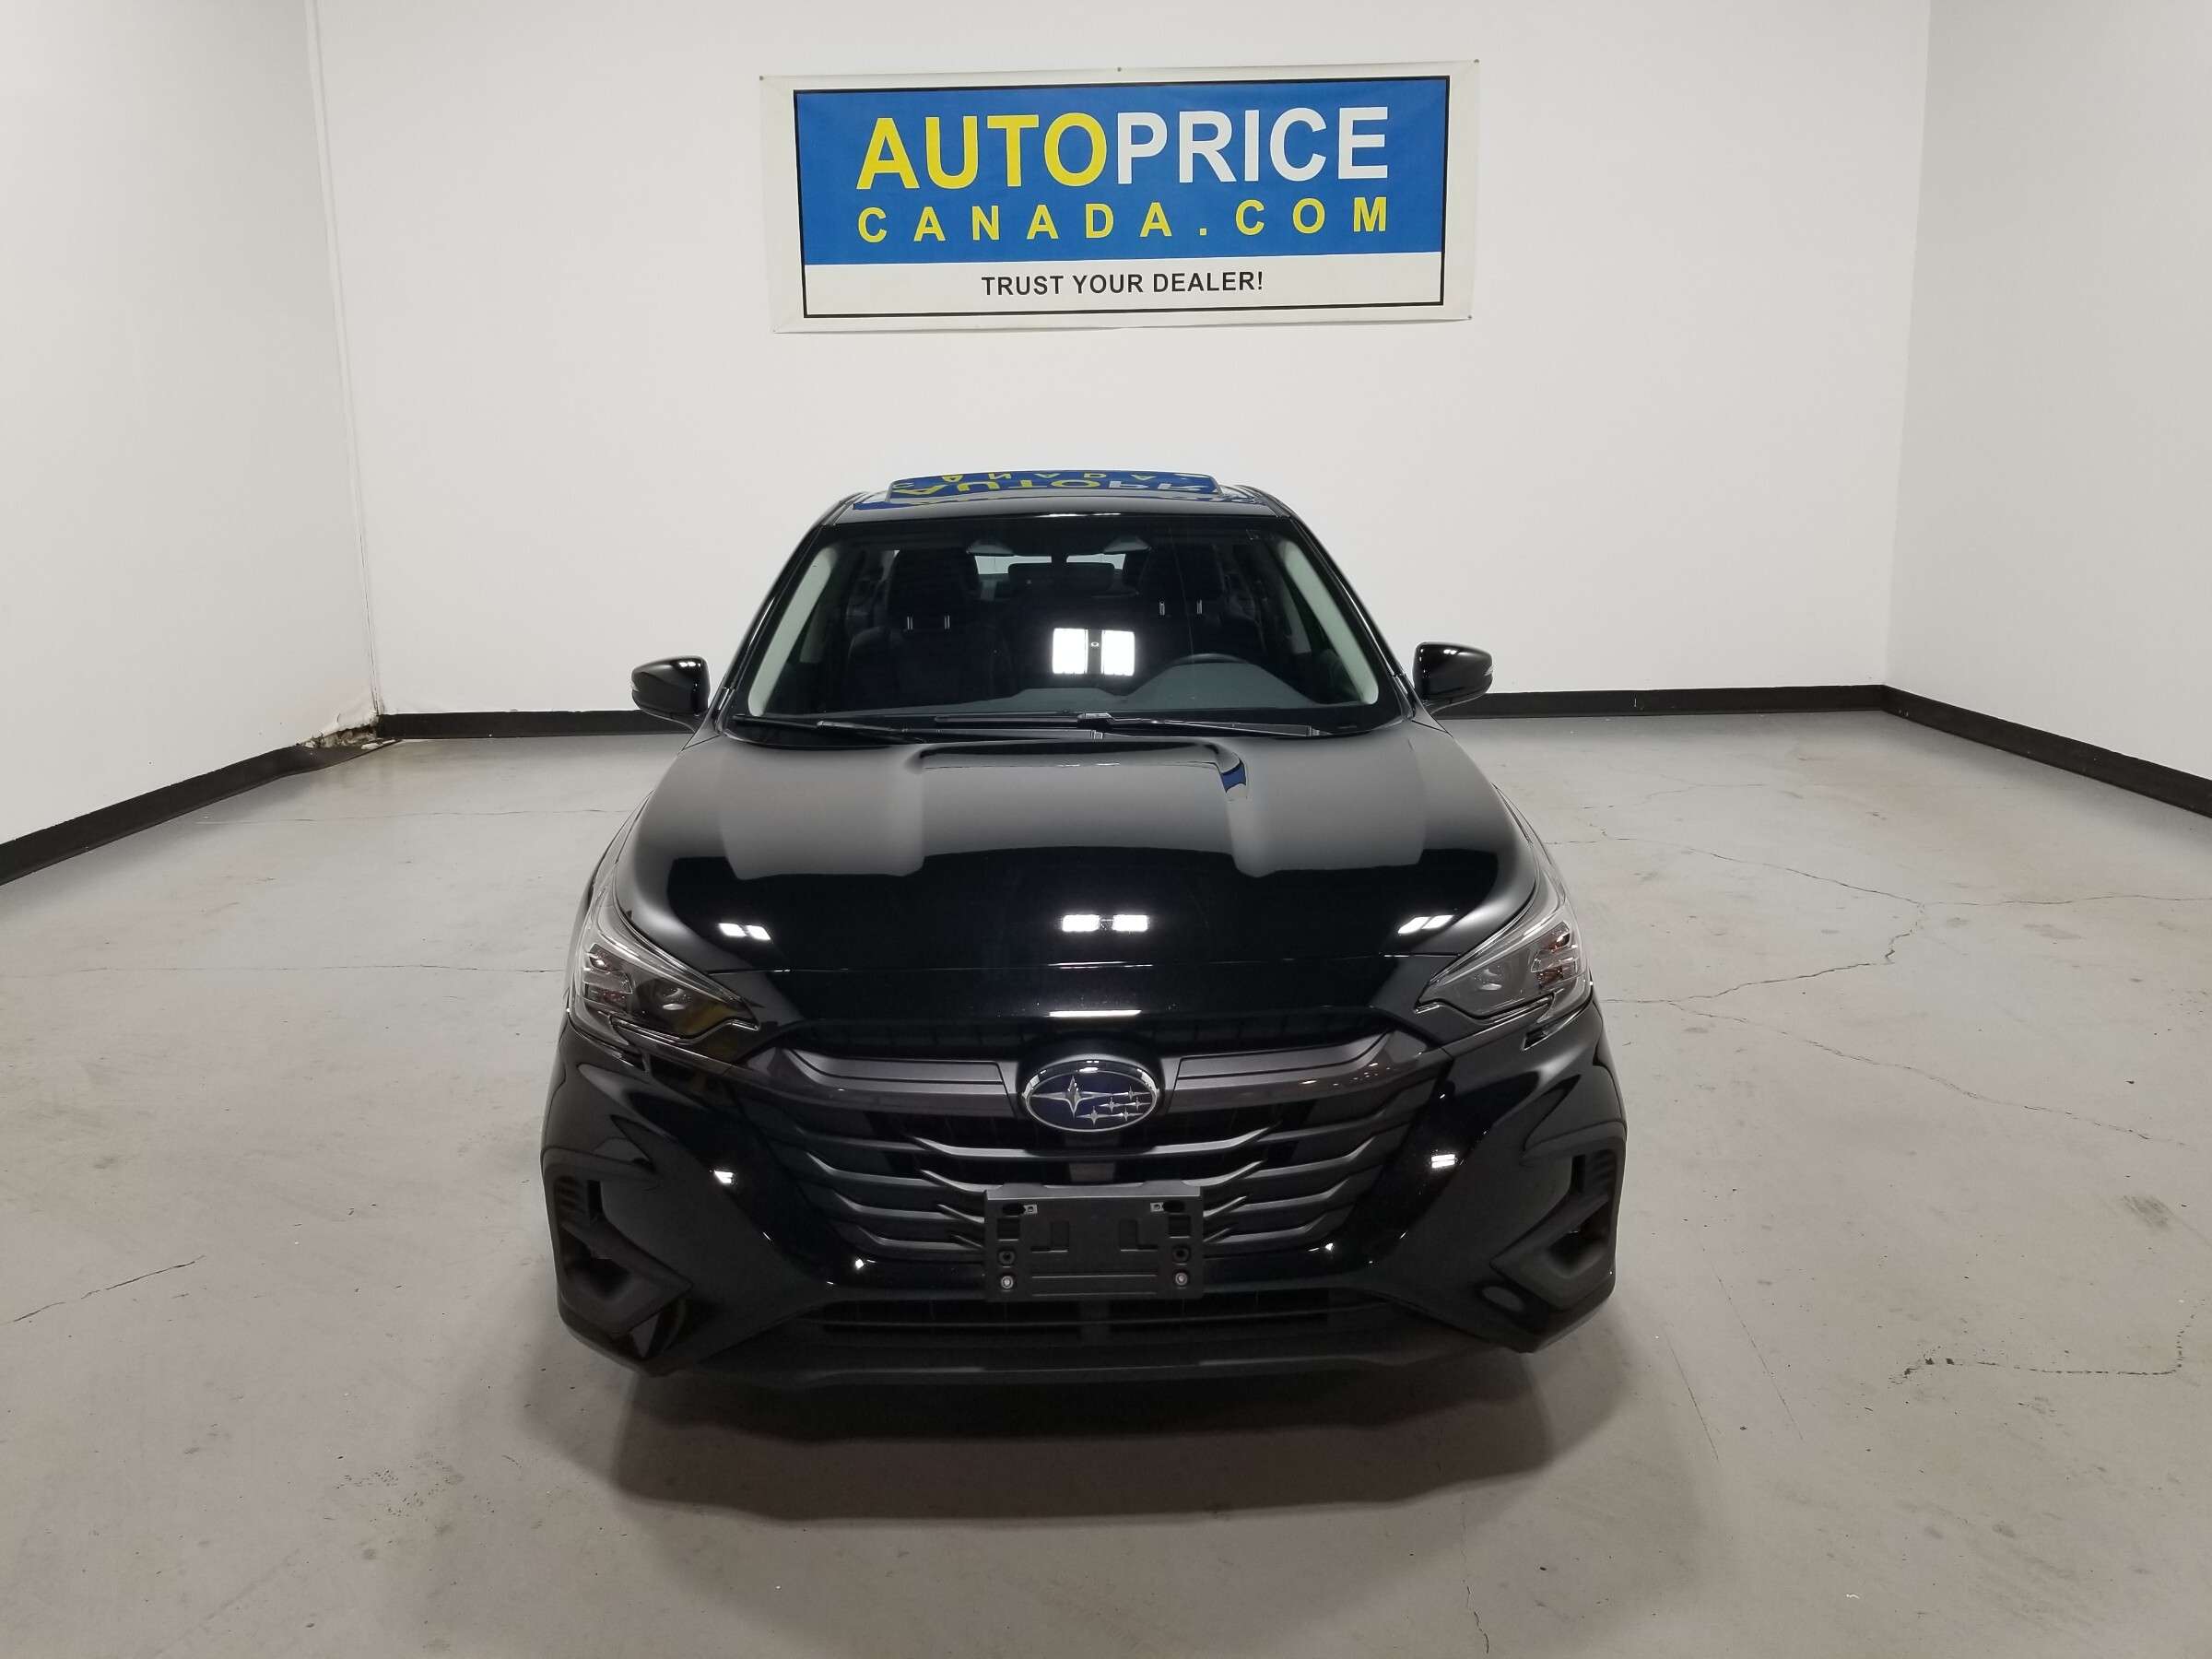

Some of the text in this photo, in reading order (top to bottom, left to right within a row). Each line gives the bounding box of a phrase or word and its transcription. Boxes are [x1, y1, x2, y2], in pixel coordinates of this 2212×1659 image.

[856, 107, 1388, 190] AUTOPRICE
[858, 196, 1387, 243] CANADA.COM
[982, 272, 1263, 296] TRUST YOUR DEALER!
